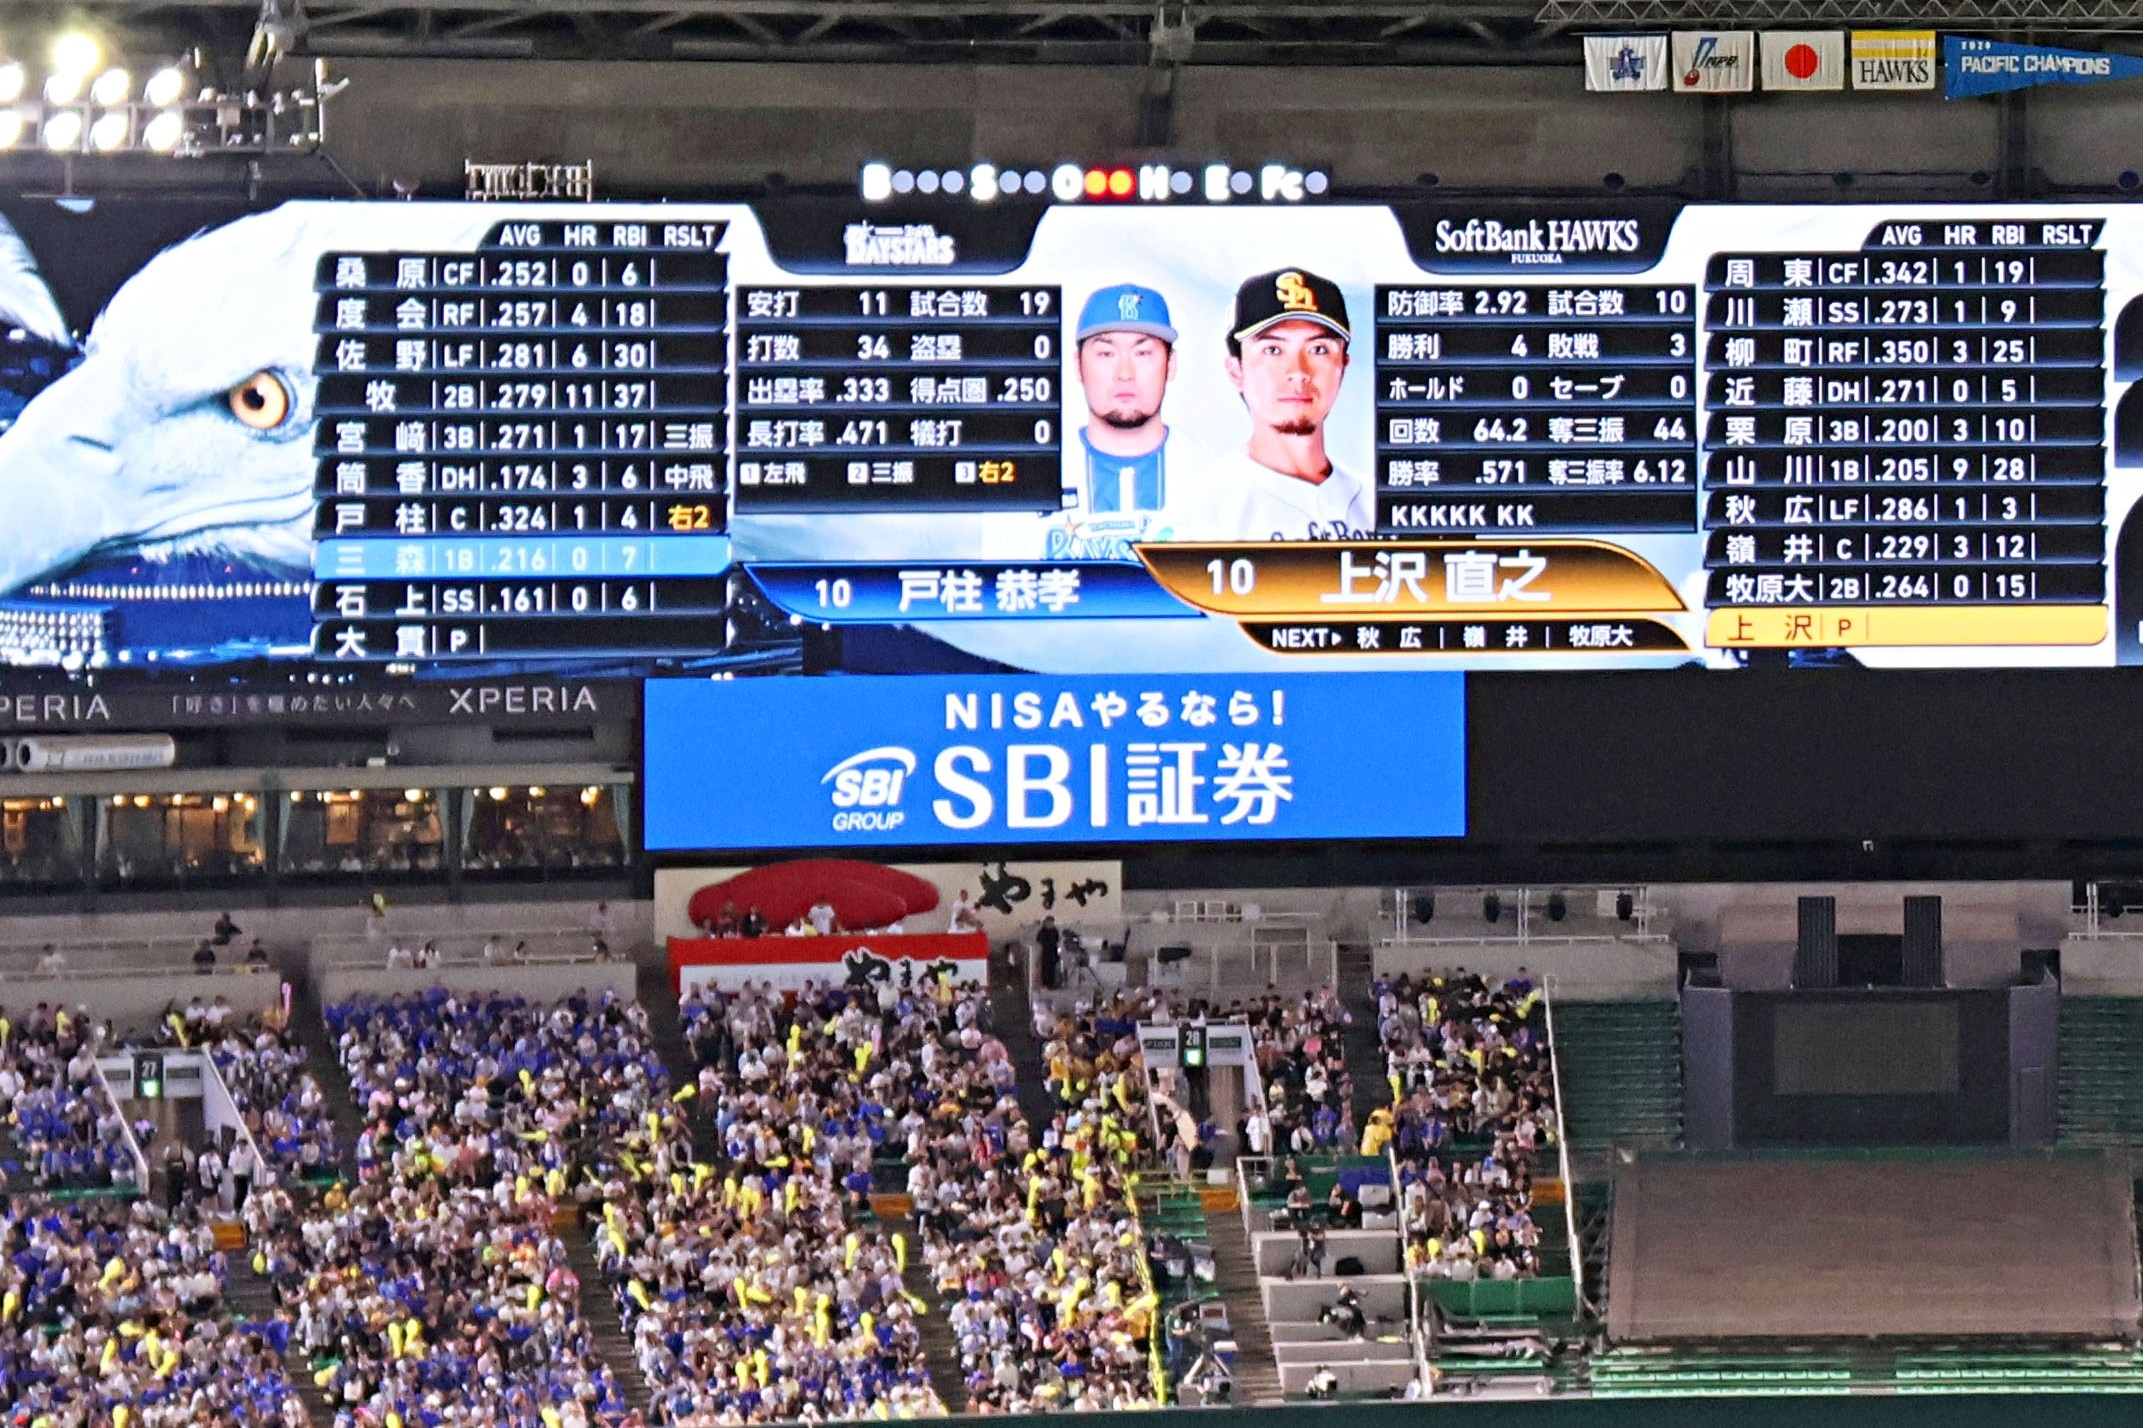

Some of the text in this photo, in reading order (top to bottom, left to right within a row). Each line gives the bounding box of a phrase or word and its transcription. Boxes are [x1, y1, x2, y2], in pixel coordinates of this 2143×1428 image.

[1704, 55, 1738, 67] NPB
[1859, 59, 1930, 83] HAWKS
[1961, 55, 2111, 76] PACIFIC CHAMPIONS
[863, 163, 891, 200] B
[971, 164, 997, 200] S
[1140, 164, 1168, 200] H
[1205, 165, 1229, 200] E
[500, 225, 715, 247] AVG HR RBI RSLT
[844, 226, 955, 265] BAYSTARS
[1436, 219, 1638, 252] SoftBank HAWKS
[1882, 225, 2092, 245] AVG HR RBI RSLT
[1512, 254, 1562, 263] FUKUOKA
[444, 262, 637, 286] CF .252 6
[1829, 261, 2023, 284] CF .342 1 19
[444, 303, 645, 327] RF .257 18
[748, 291, 885, 317] 安打 11
[911, 291, 1049, 317] 試合数 19
[1389, 291, 1526, 316] 防御率 2.92
[1548, 290, 1685, 315] 試合数 10
[1829, 301, 2015, 323] SS .273 1 9
[445, 344, 645, 368] LF .281 30
[748, 336, 889, 362] 打数 34
[911, 335, 1049, 361] 盗塁 0
[1389, 334, 1527, 359] 勝利 4
[1549, 334, 1685, 358] 敗戦 3
[1829, 341, 2023, 363] RF .350 3 25
[366, 381, 644, 412] 牧 2B .279 11 37
[748, 378, 889, 404] 出塁率 .333
[911, 378, 1049, 403] 得点圏 .250
[1390, 377, 1527, 400] ホールド 0
[1550, 375, 1685, 399] セーブ 0
[1828, 380, 2015, 402] DH .271 0 5
[444, 425, 713, 450] 3B .271 17 三振
[748, 421, 886, 447] 長打率 .471
[911, 421, 1050, 446] 犠打 0
[1390, 418, 1526, 443] 回数 64.2
[1549, 418, 1685, 443] 奪三振 44
[1830, 419, 2024, 441] 3B .200 3 10
[442, 465, 713, 490] DH .174 6 中飛
[872, 462, 913, 483] 三振
[979, 461, 1014, 483] 右2
[1389, 461, 1524, 486] 勝率 .571
[1549, 460, 1685, 485] 奪三振率 6.12
[1831, 458, 2024, 481] 1B .205 9 28
[451, 505, 709, 531] C .324 4 右2
[1392, 505, 1533, 526] KKKKK KK
[1831, 497, 2016, 520] LF .286 1 3
[1837, 536, 2023, 559] C .229 3 12
[1208, 550, 1552, 603] 10 上沢 直之
[1727, 574, 2024, 603] 牧原大 2B .264 0 15
[443, 587, 637, 612] SS .161 6
[816, 569, 1079, 613] 10 戸柱 恭孝
[1273, 625, 1633, 647] NEXT 牧原大
[1839, 620, 1851, 635] P
[451, 631, 466, 652] P
[449, 686, 597, 713] XPERIA
[832, 768, 906, 808] SBI
[934, 743, 1292, 829] SBI証券
[833, 812, 904, 830] GROUP
[979, 864, 1107, 914] やまや
[1186, 1030, 1200, 1045] 28
[141, 1061, 158, 1077] 27
